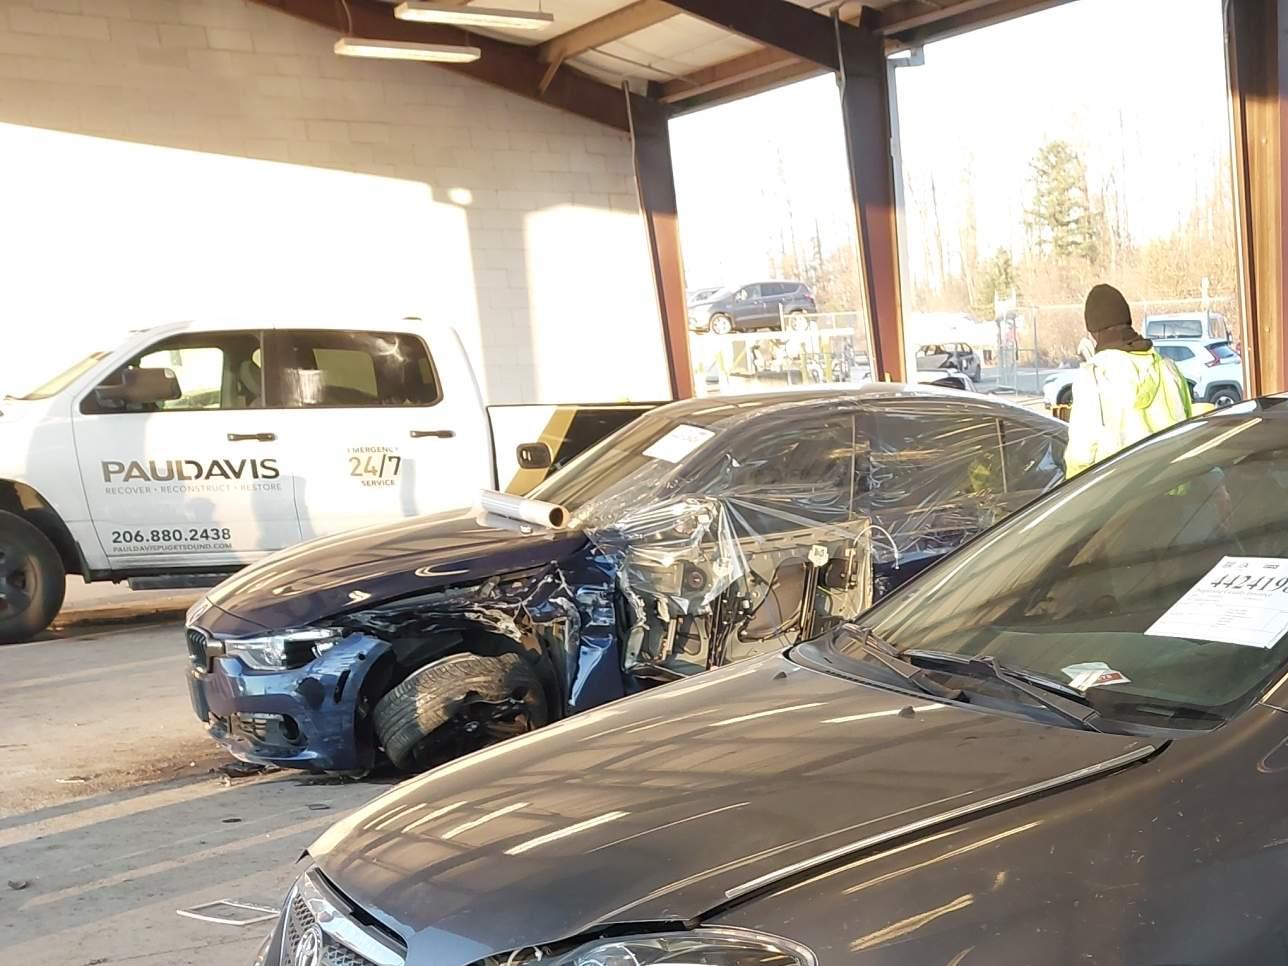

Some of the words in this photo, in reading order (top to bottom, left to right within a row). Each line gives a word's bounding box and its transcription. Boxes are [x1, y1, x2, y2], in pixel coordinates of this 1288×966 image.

[349, 453, 401, 478] 24/7
[105, 486, 151, 495] RECOVER
[160, 484, 230, 494] RECONSTRUCT
[240, 483, 281, 492] RESTORE
[361, 479, 395, 487] SERVICE
[111, 528, 232, 544] 206.880.2438
